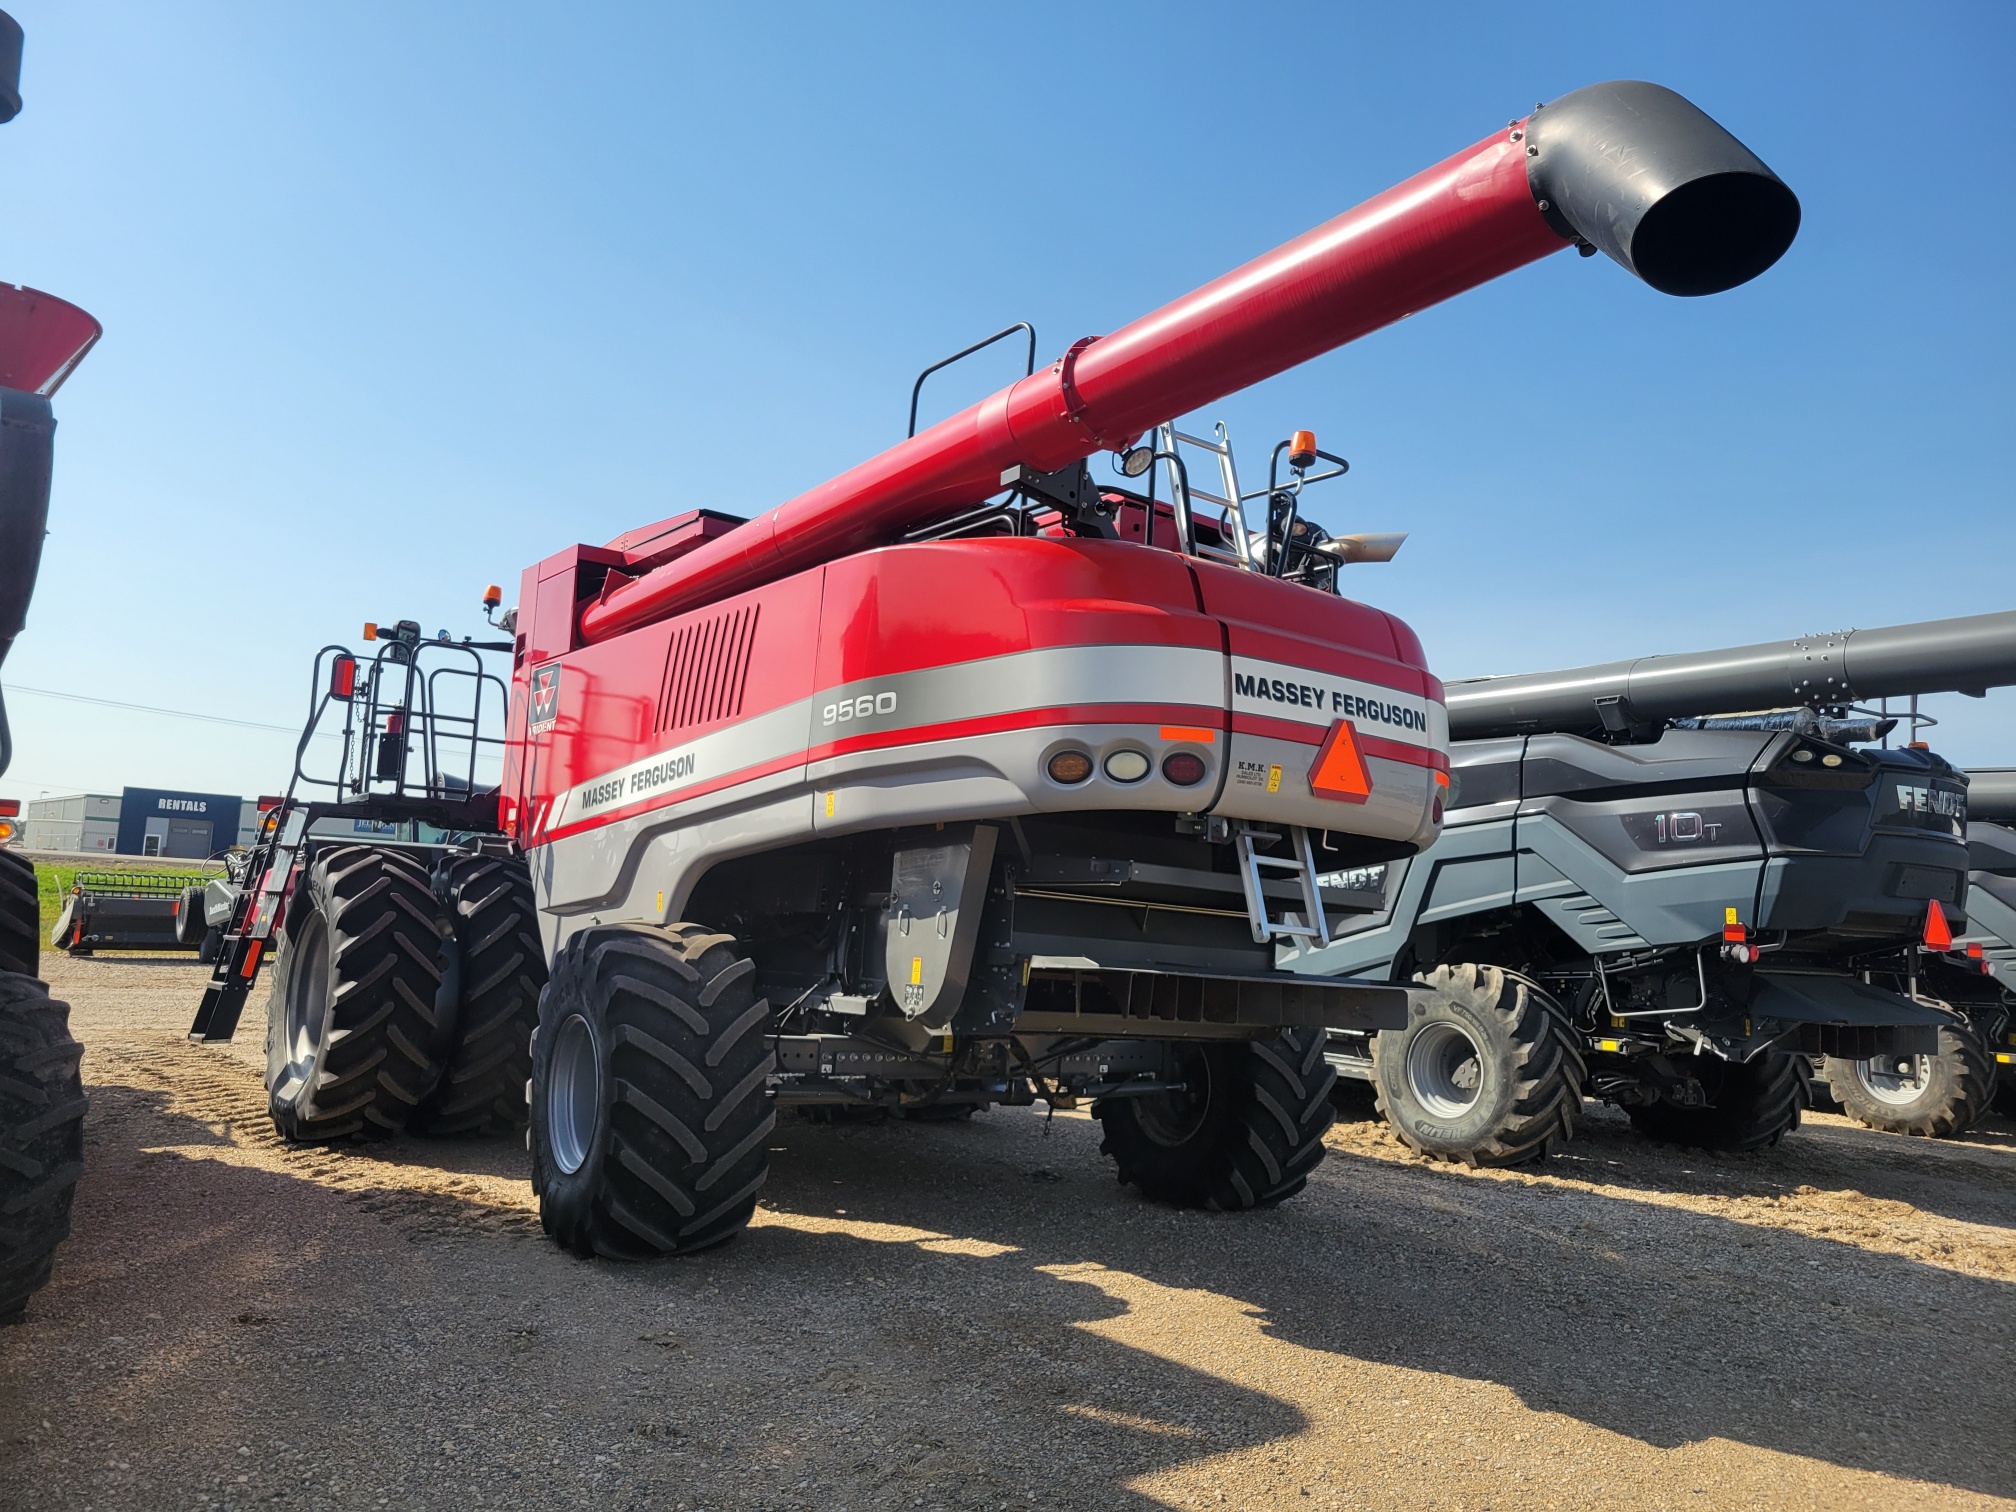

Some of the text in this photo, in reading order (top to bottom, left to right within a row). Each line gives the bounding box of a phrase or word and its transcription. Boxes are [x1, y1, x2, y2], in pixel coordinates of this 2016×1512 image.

[823, 691, 897, 726] 9560
[1235, 673, 1427, 733] MASSEY FERGUSON
[582, 752, 695, 810] MASSEY FERGUSON
[1238, 761, 1266, 773] K.M.K.
[158, 798, 207, 812] RENTALS
[1896, 785, 1967, 818] FENDT
[1654, 812, 1722, 843] 10T
[1315, 865, 1385, 891] ENDT
